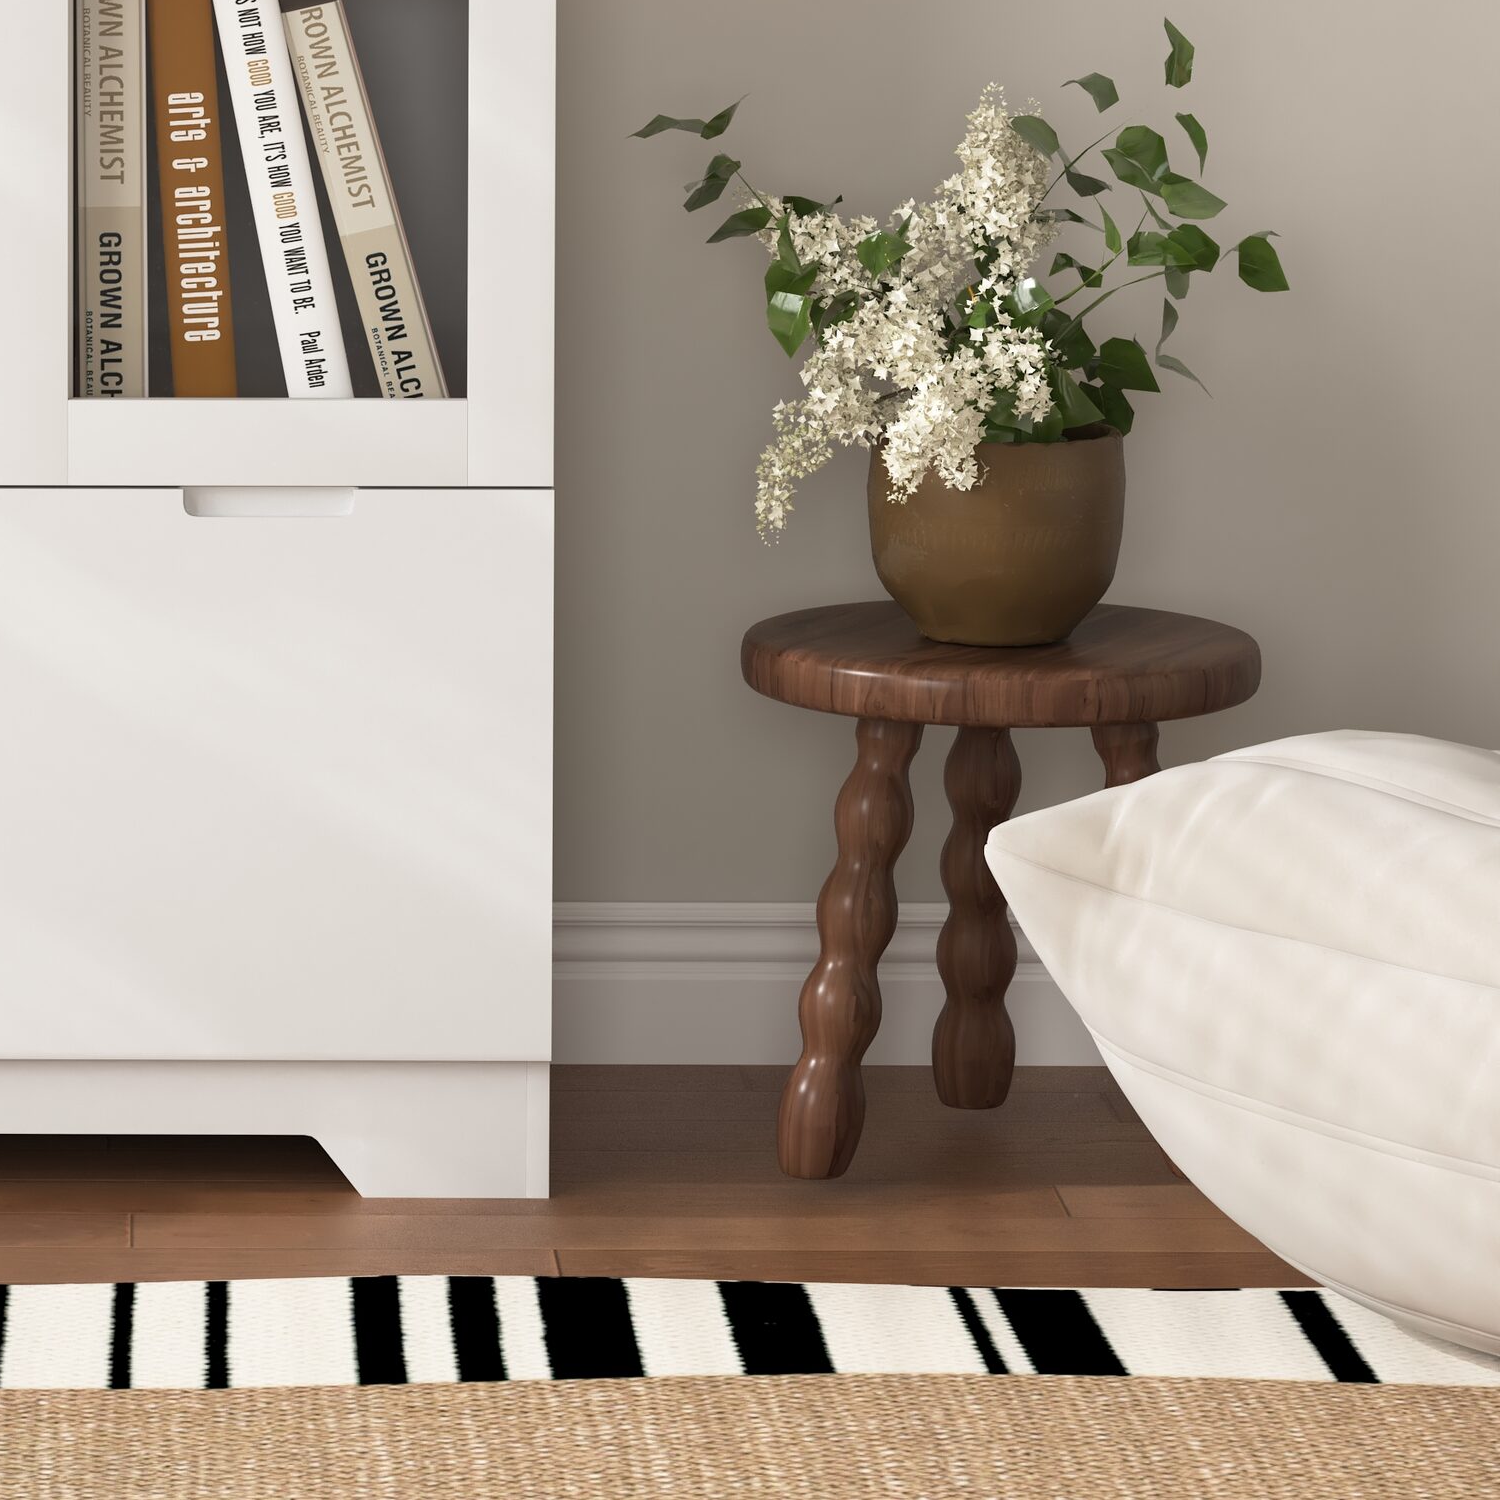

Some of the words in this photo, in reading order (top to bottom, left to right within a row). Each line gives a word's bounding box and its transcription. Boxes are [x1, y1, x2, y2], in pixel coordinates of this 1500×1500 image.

[237, 8, 262, 28] NOT
[84, 8, 92, 68] BOTANICAL
[242, 32, 267, 55] HOW
[247, 59, 272, 87] GOOD
[99, 45, 125, 185] ALCHEMIST
[253, 89, 277, 112] YOU
[297, 55, 317, 115] BOTANICAL
[312, 115, 330, 155] BEAUTY
[168, 92, 211, 142] arts
[257, 115, 282, 139] ARE,
[263, 141, 287, 162] IT'S
[320, 84, 376, 209] ALCHEMIST
[267, 164, 292, 188] HOW
[272, 191, 298, 219] GOOD
[279, 222, 303, 244] YOU
[174, 185, 223, 342] architecture
[284, 246, 309, 276] WANT
[99, 232, 122, 329] GROWN
[290, 279, 312, 294] TO
[293, 296, 316, 315] BE.
[365, 251, 408, 342] GROWN
[85, 310, 93, 364] BOTANICAL
[300, 330, 324, 355] Paul
[100, 338, 124, 398] ALCH
[305, 358, 329, 389] Arden
[371, 327, 390, 377] BOTANICAL
[386, 381, 396, 398] BEA
